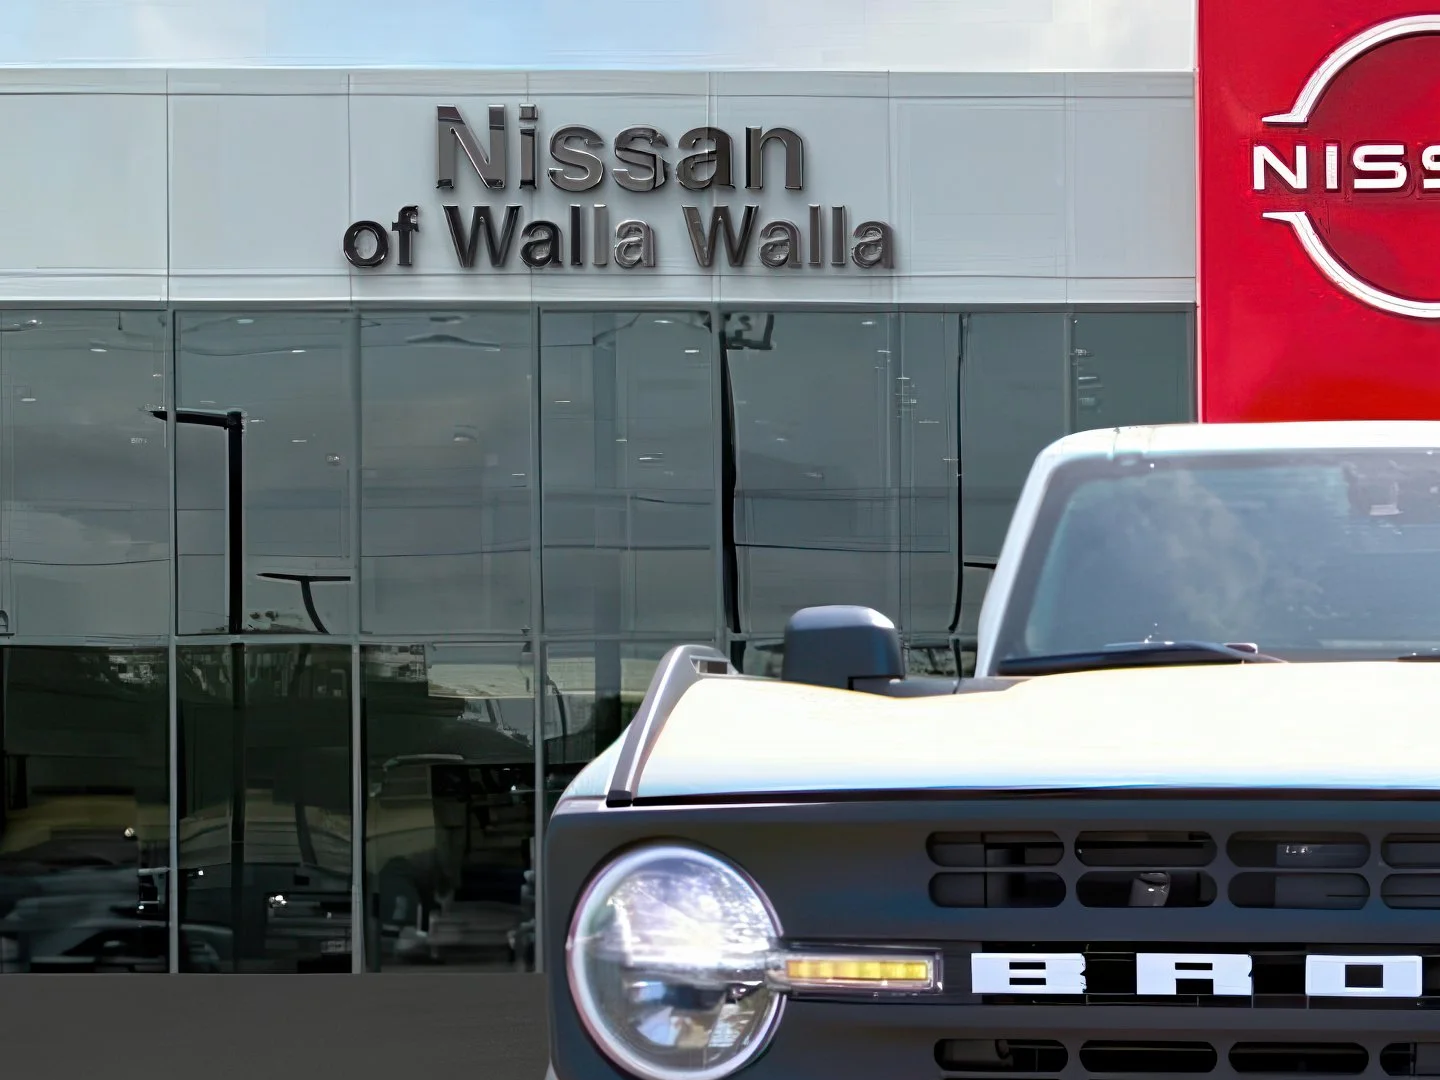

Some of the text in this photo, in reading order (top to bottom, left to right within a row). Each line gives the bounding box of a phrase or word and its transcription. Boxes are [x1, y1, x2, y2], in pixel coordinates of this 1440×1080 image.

[436, 104, 804, 192] Nissan
[344, 204, 895, 268] of Walla Walla
